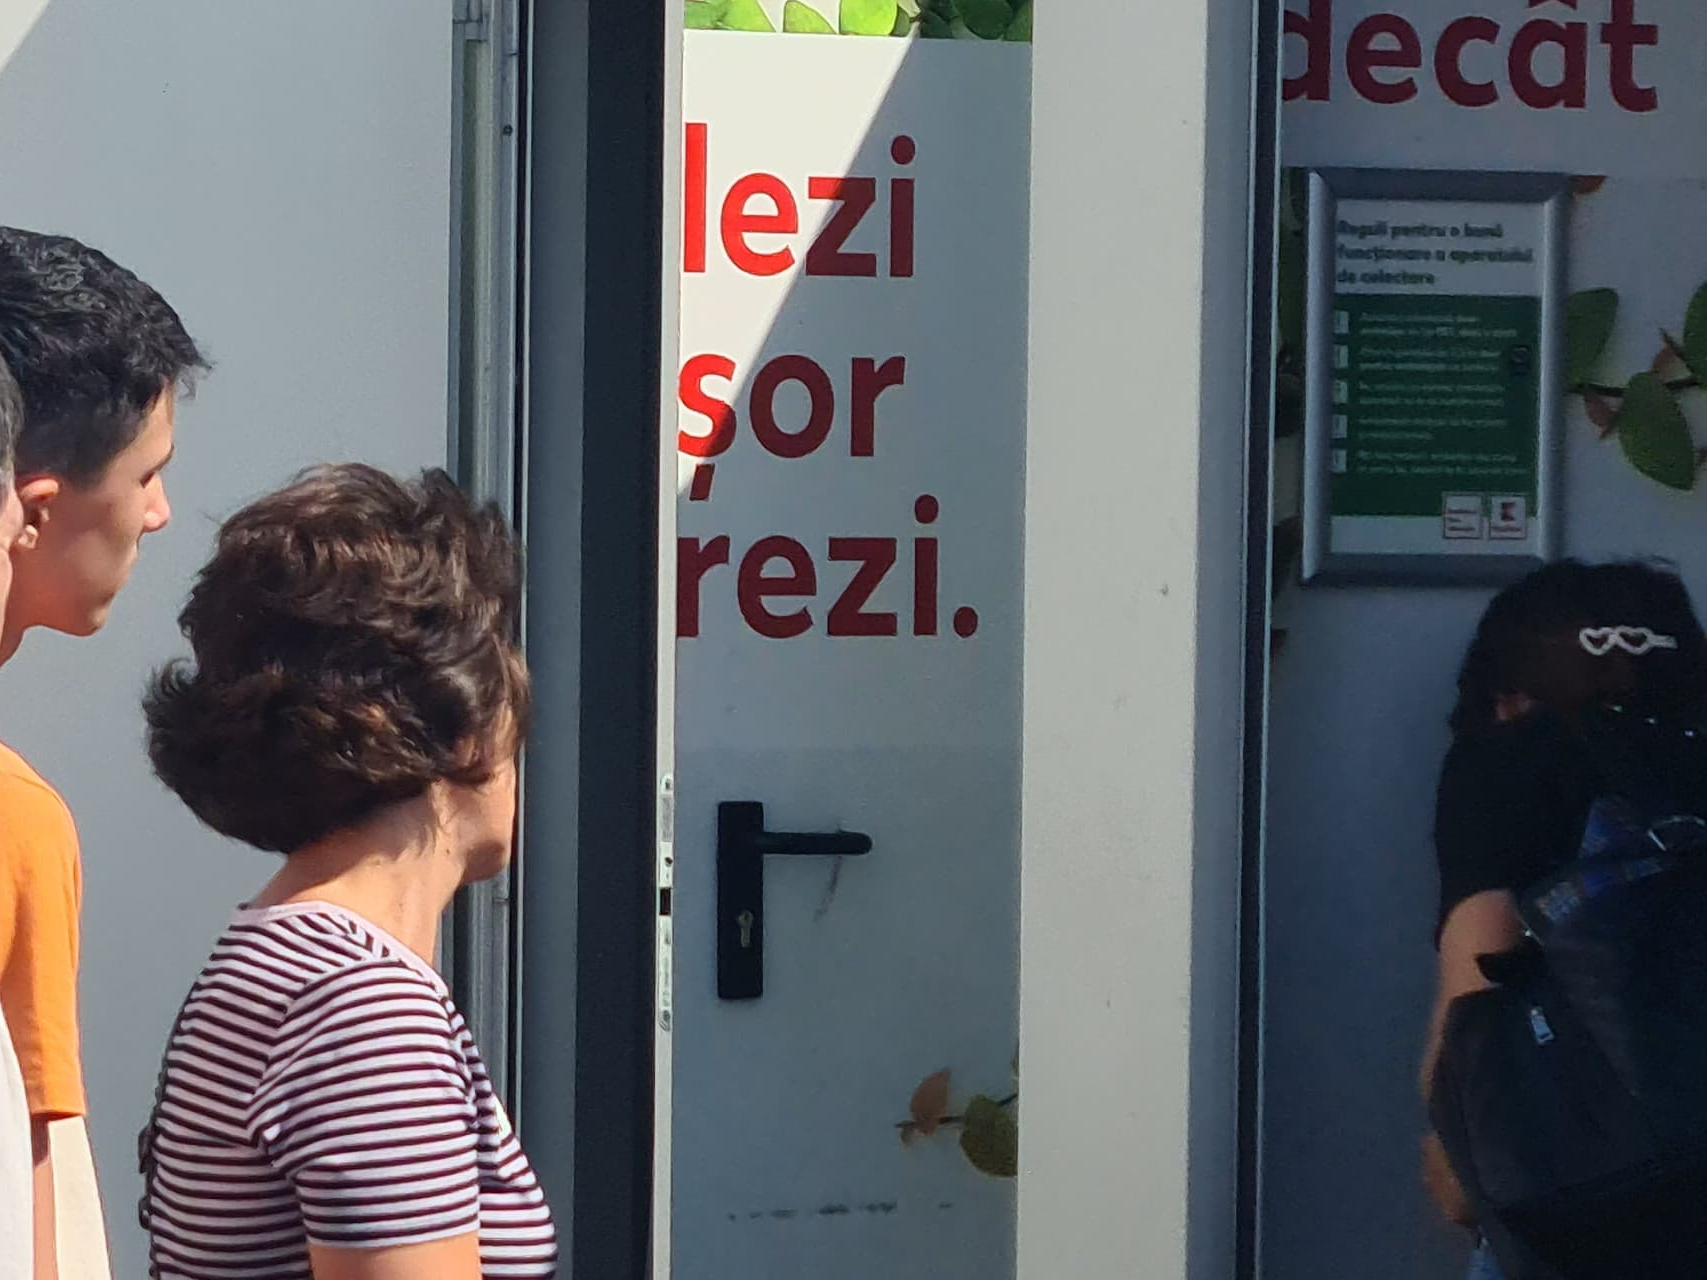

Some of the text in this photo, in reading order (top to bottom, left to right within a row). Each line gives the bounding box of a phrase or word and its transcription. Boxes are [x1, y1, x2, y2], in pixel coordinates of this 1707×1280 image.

[683, 122, 916, 278] lezi
[678, 353, 906, 502] șor
[676, 494, 979, 639] rezi.
